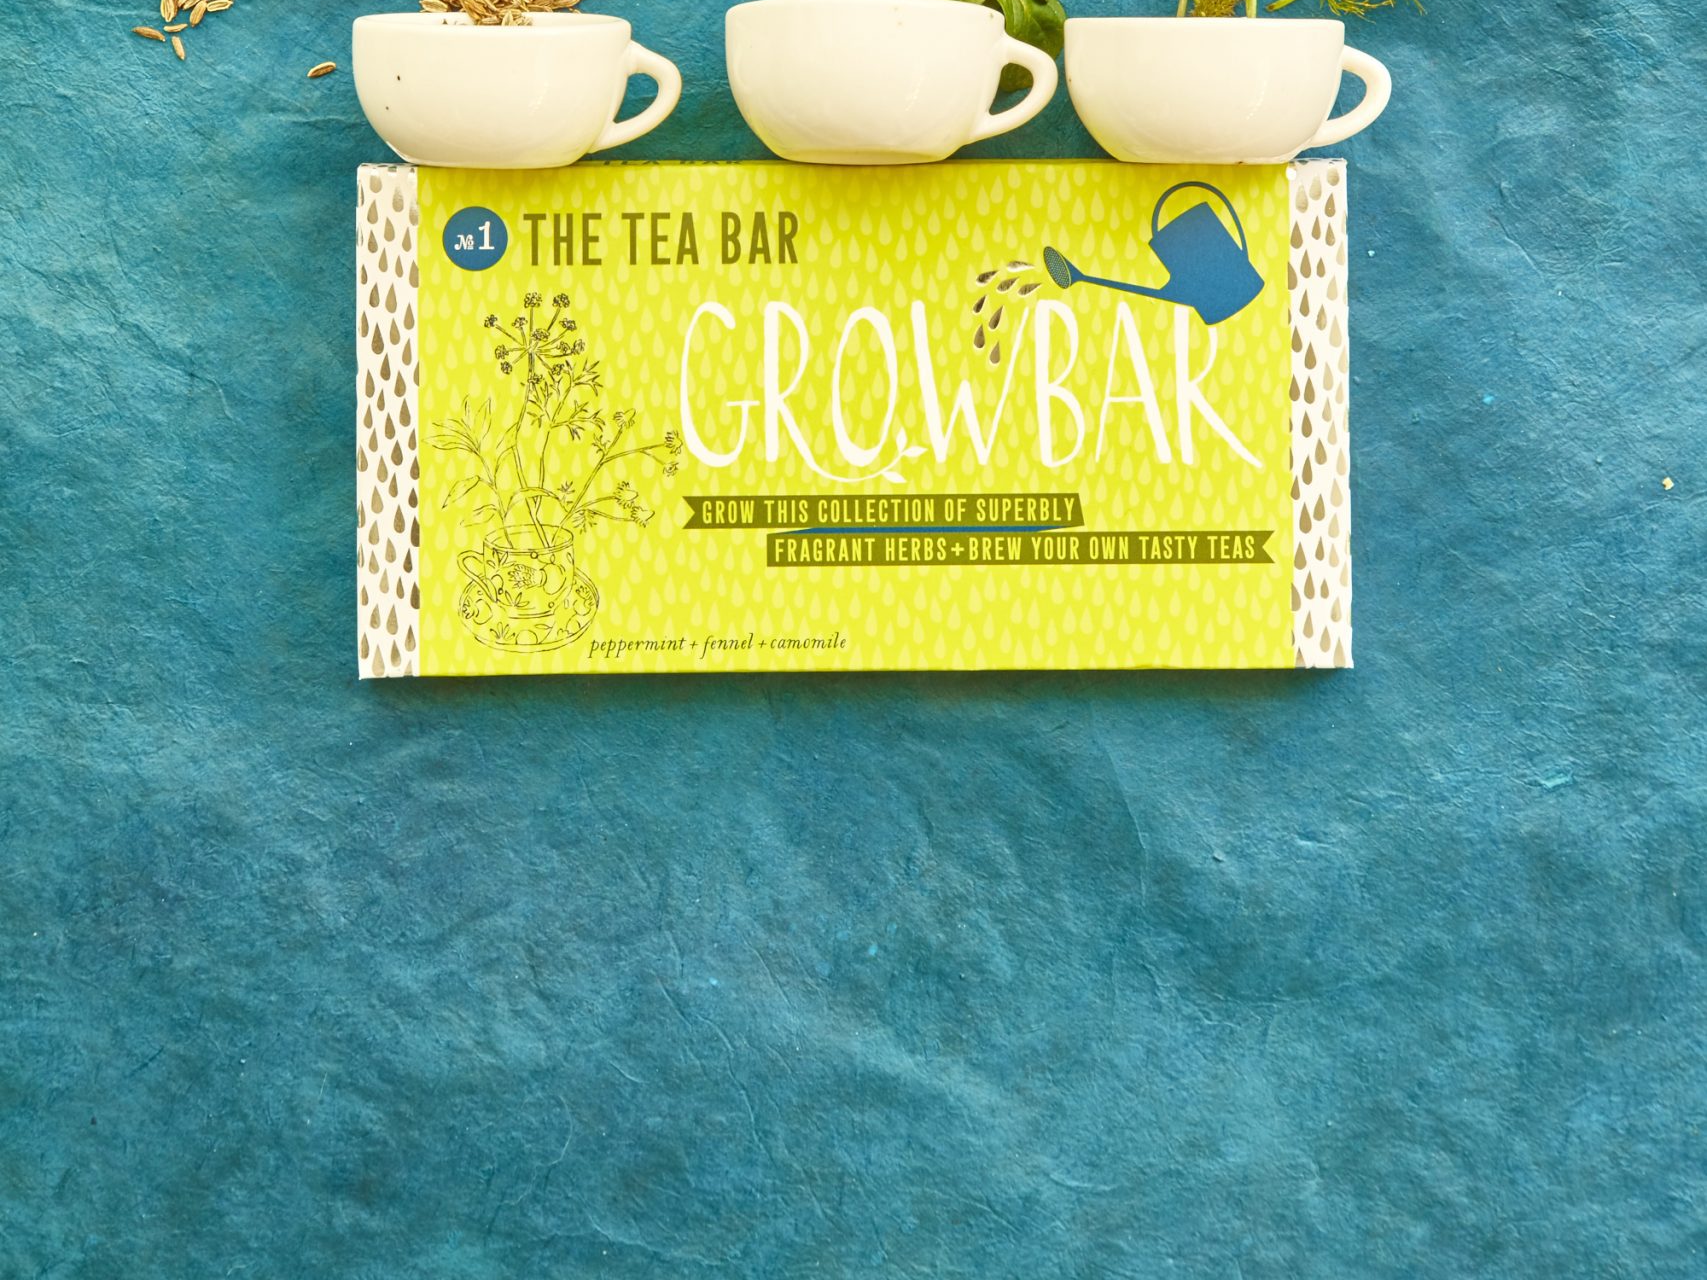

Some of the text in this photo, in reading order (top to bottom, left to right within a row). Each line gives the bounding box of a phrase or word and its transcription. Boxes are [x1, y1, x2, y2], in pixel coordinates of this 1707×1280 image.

[523, 211, 798, 266] THE TEA BAR
[702, 497, 1075, 524] GROW THIS COLLECTION OF SUPERBLY
[775, 538, 876, 562] FRAGRANT
[1031, 536, 1080, 560] YOUR
[1089, 536, 1129, 560] OWN
[1139, 535, 1198, 559] TASTY
[1207, 535, 1255, 559] TEAS
[588, 635, 687, 658] peppermint
[700, 632, 754, 660] fennel
[770, 631, 847, 651] camomile
